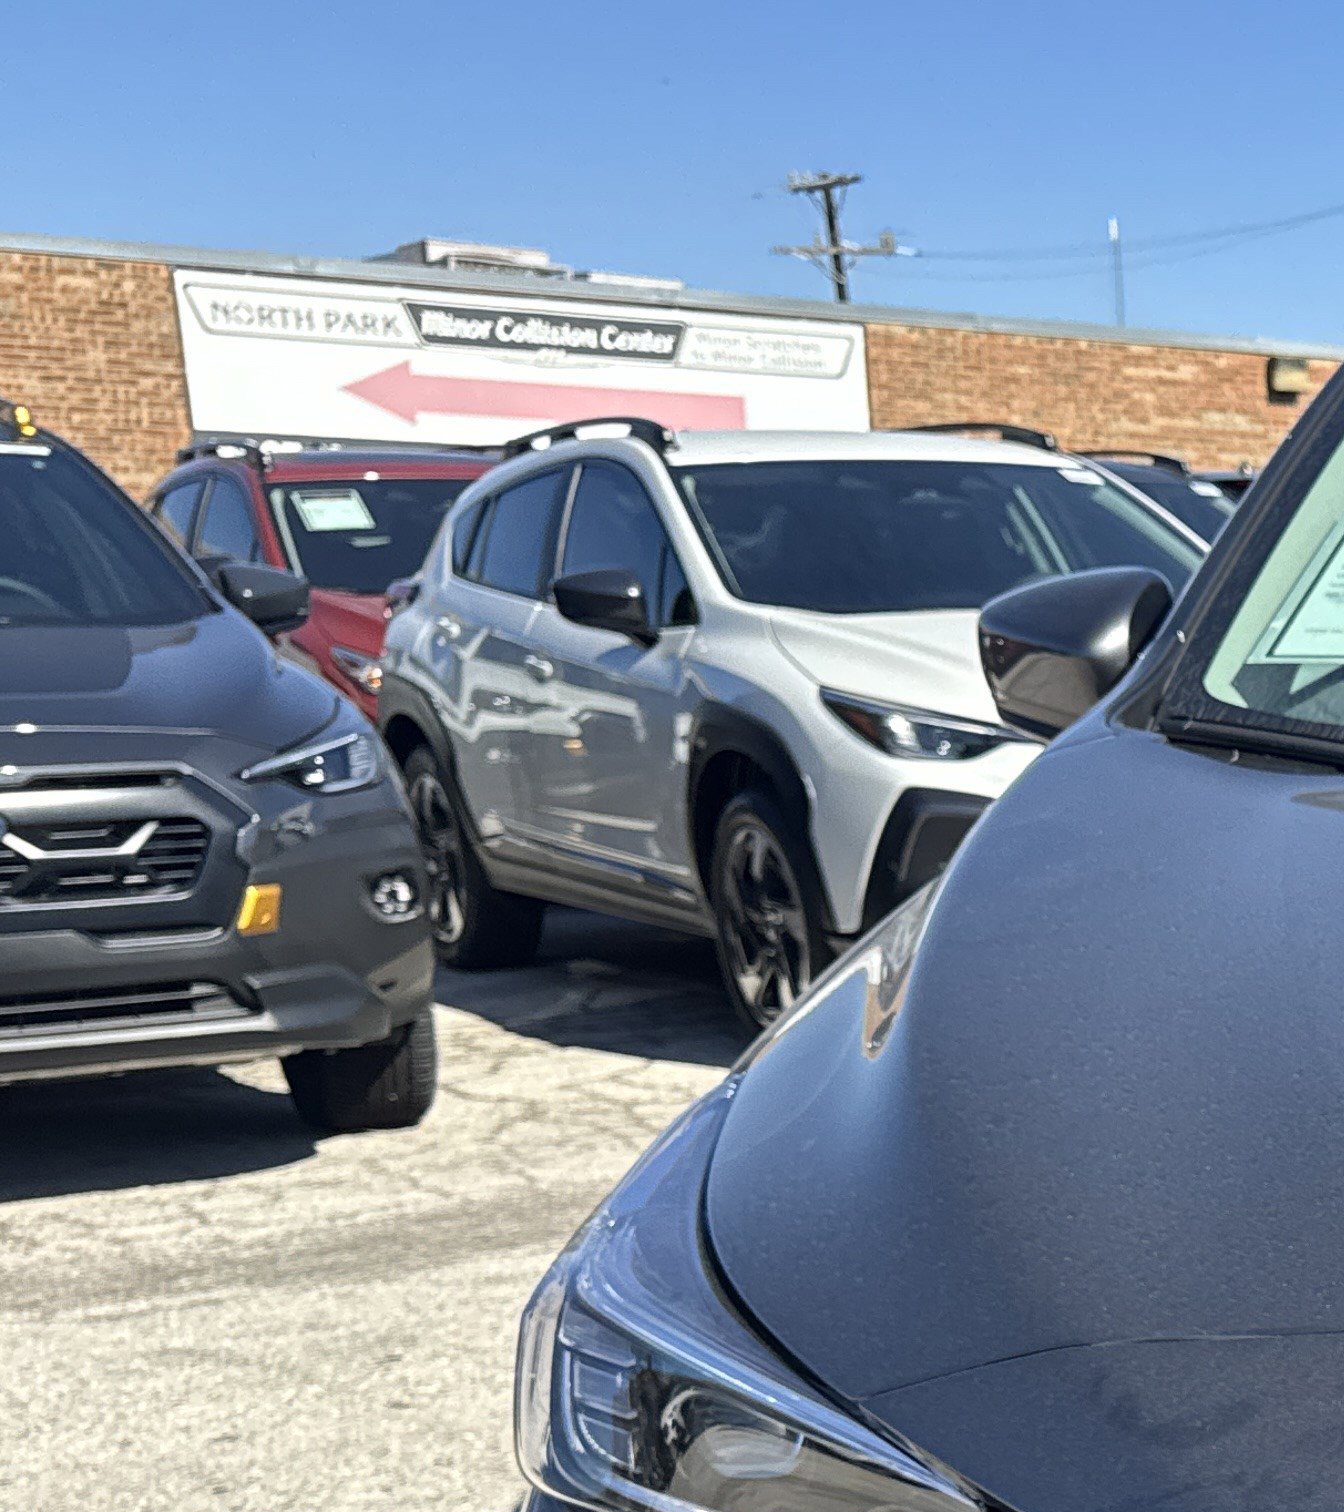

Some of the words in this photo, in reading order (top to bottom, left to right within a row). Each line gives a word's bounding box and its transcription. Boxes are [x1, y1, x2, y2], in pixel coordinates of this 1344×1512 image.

[210, 299, 315, 331] NORTH
[323, 310, 403, 338] PARK
[420, 309, 492, 340] Minor
[494, 315, 598, 349] Collision
[600, 325, 676, 354] Center
